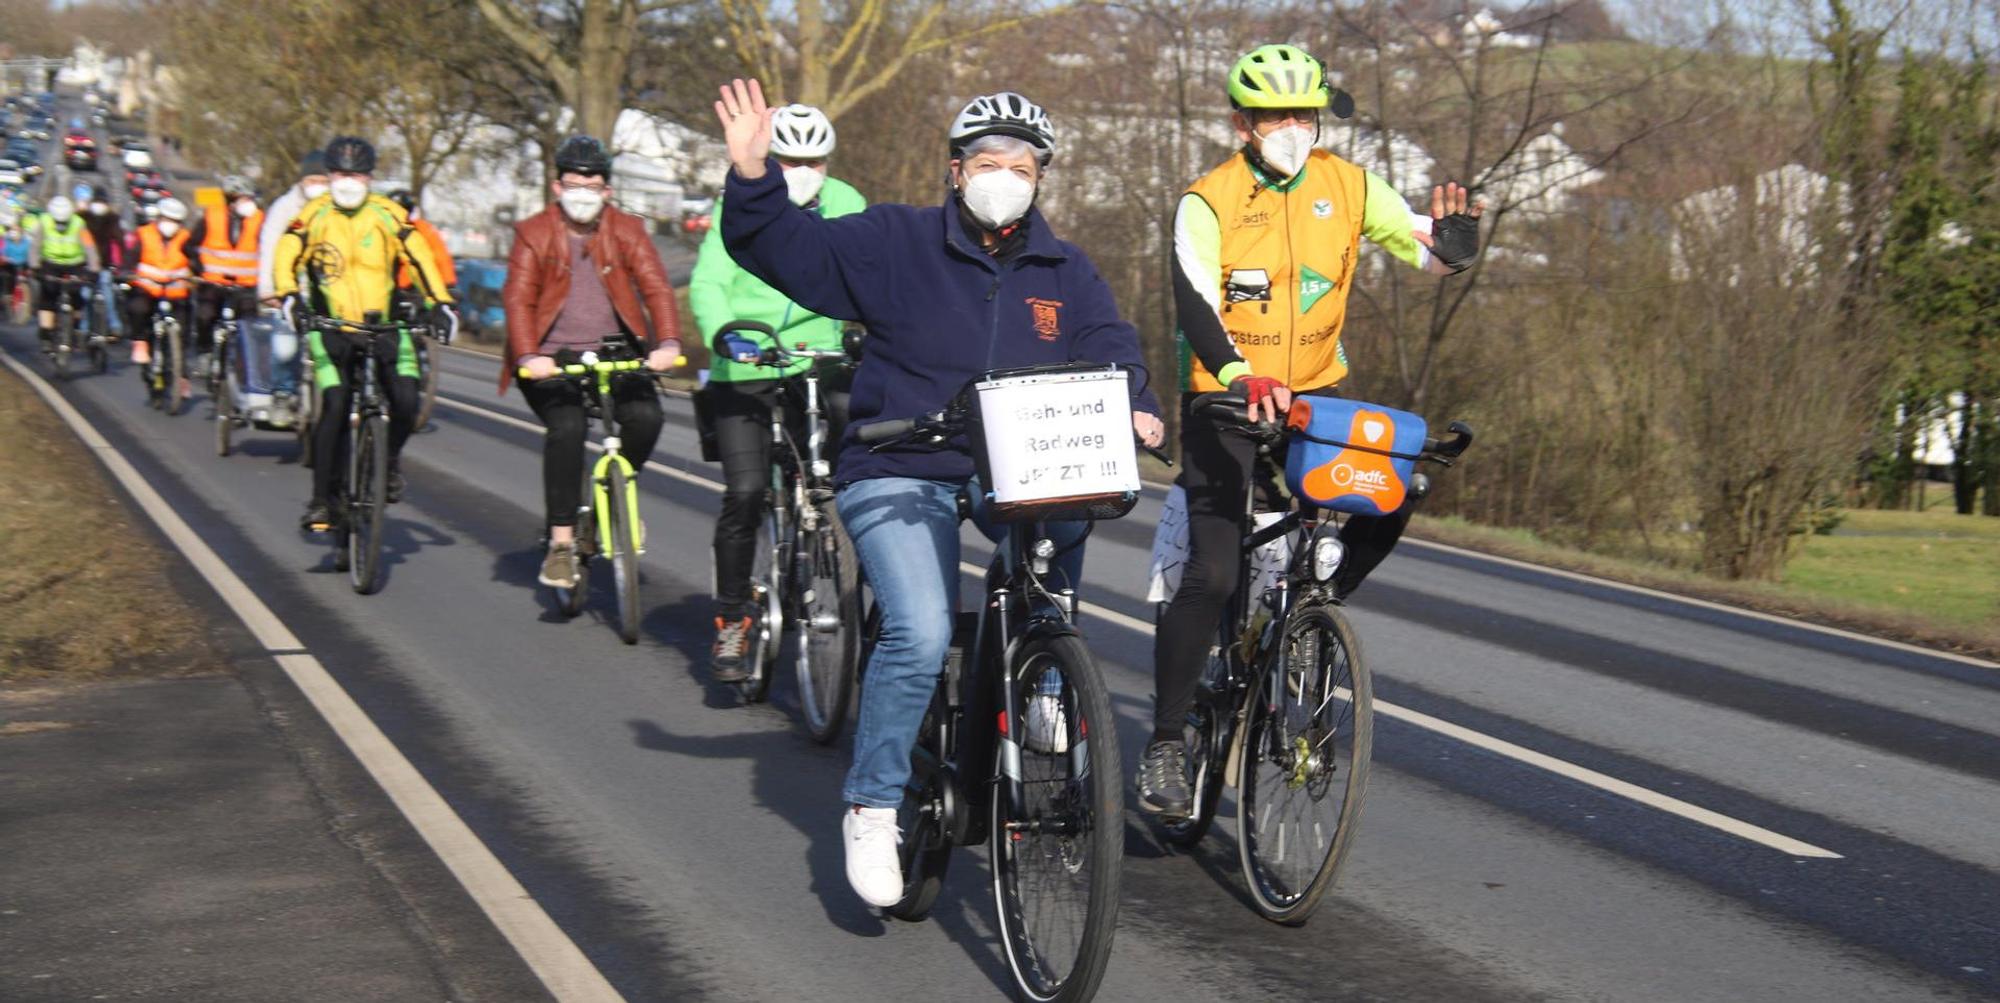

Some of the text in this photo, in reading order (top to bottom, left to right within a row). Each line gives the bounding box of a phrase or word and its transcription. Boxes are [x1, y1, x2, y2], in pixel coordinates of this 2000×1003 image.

[1069, 398, 1105, 416] und
[1024, 433, 1105, 452] Radweg
[1018, 464, 1085, 485] JEZT
[1354, 470, 1388, 485] adfc
